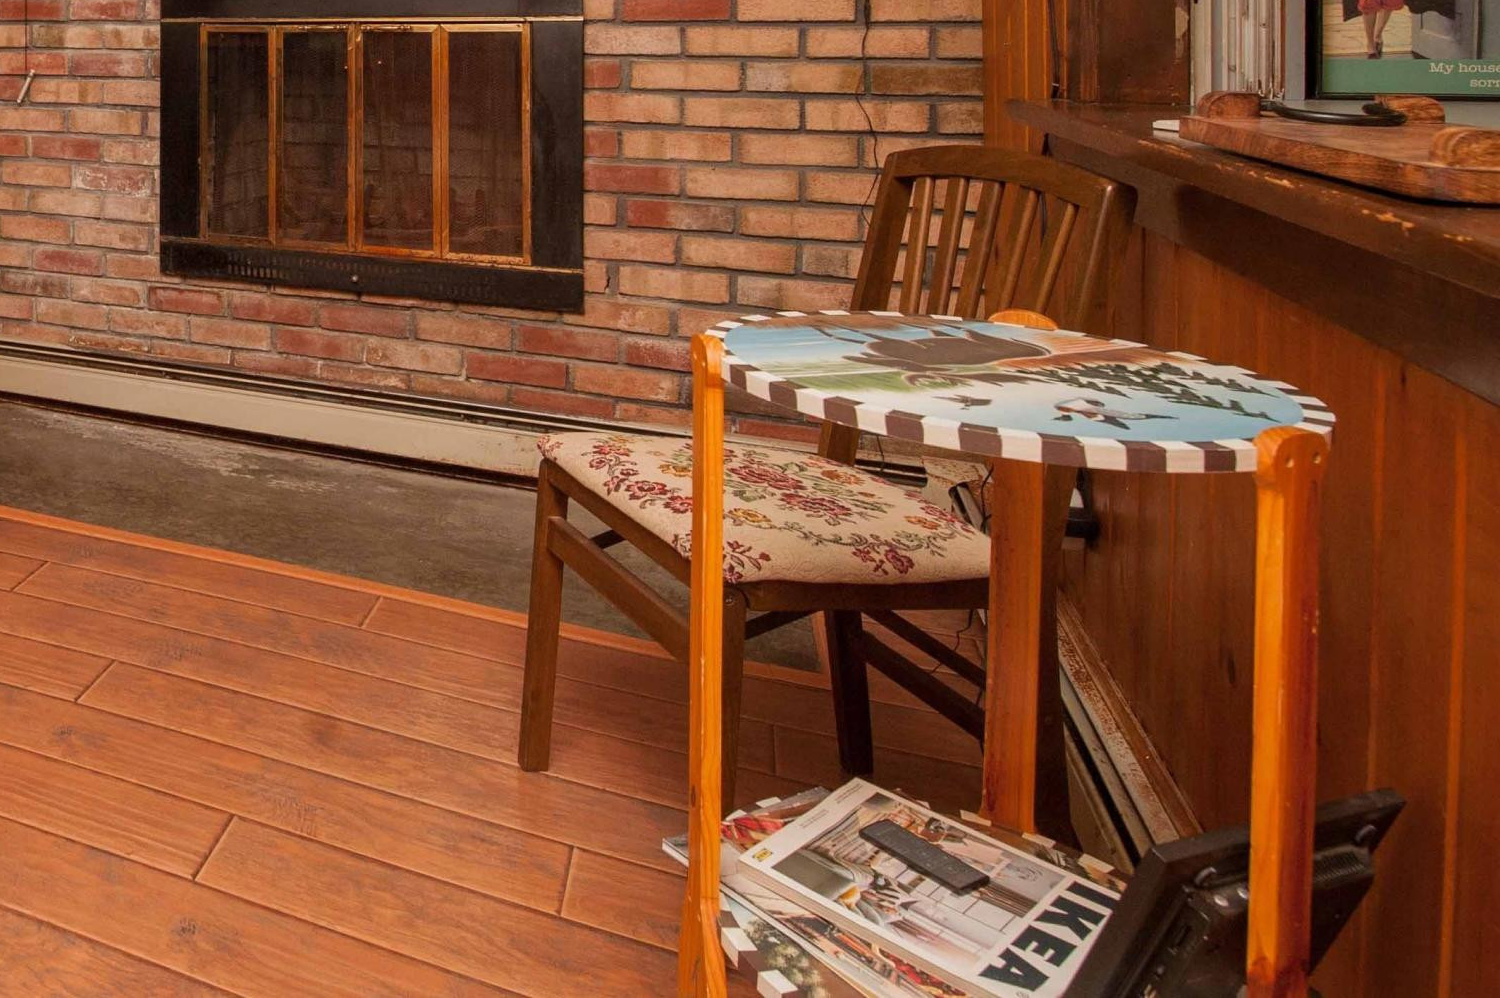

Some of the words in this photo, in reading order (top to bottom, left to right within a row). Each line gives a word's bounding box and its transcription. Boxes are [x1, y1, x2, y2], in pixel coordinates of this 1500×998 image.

[1428, 62, 1454, 74] My
[1469, 79, 1500, 88] sorr
[978, 881, 1116, 992] IKEA
